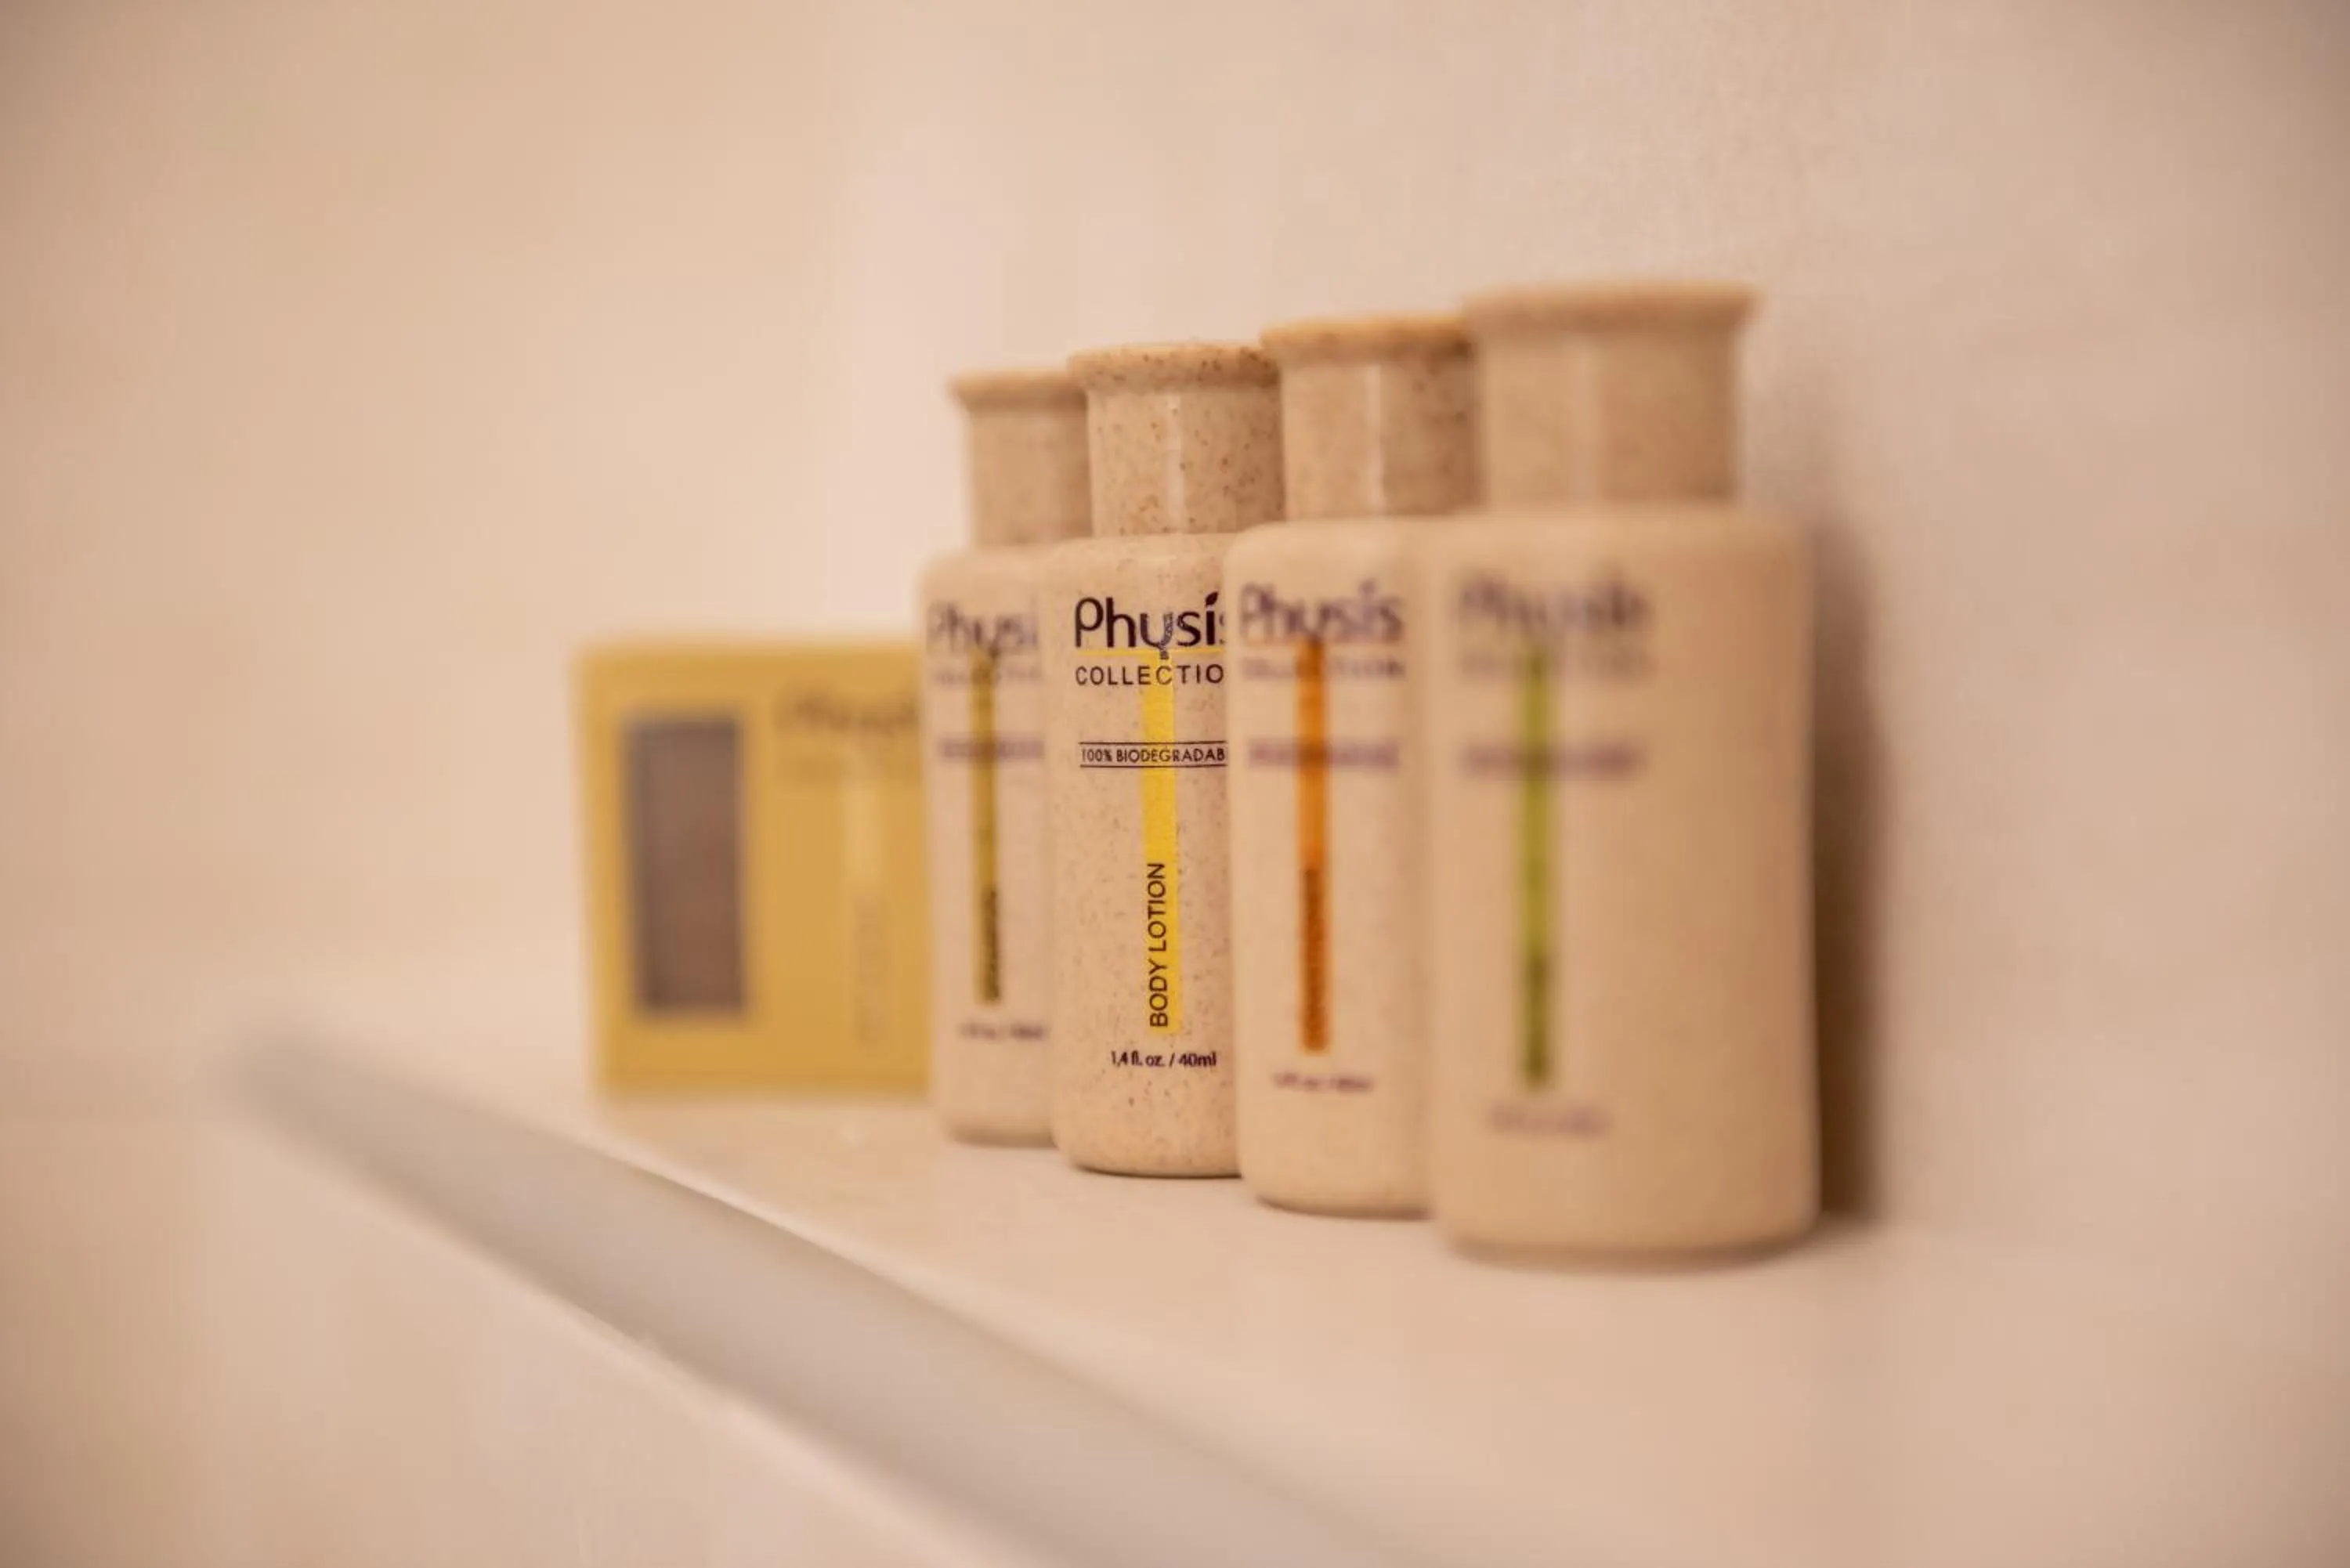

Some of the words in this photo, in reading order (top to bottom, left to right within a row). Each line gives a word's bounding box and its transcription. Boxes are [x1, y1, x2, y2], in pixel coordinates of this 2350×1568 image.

[927, 598, 1039, 660] Physi
[1075, 591, 1225, 660] Physi
[1075, 663, 1224, 686] COLLECTIO
[1081, 748, 1113, 763] 100%
[1115, 747, 1227, 763] BIODEGRADAB
[1146, 862, 1167, 953] LOTION
[1148, 958, 1169, 1028] BODY
[1178, 1050, 1218, 1068] 40ml
